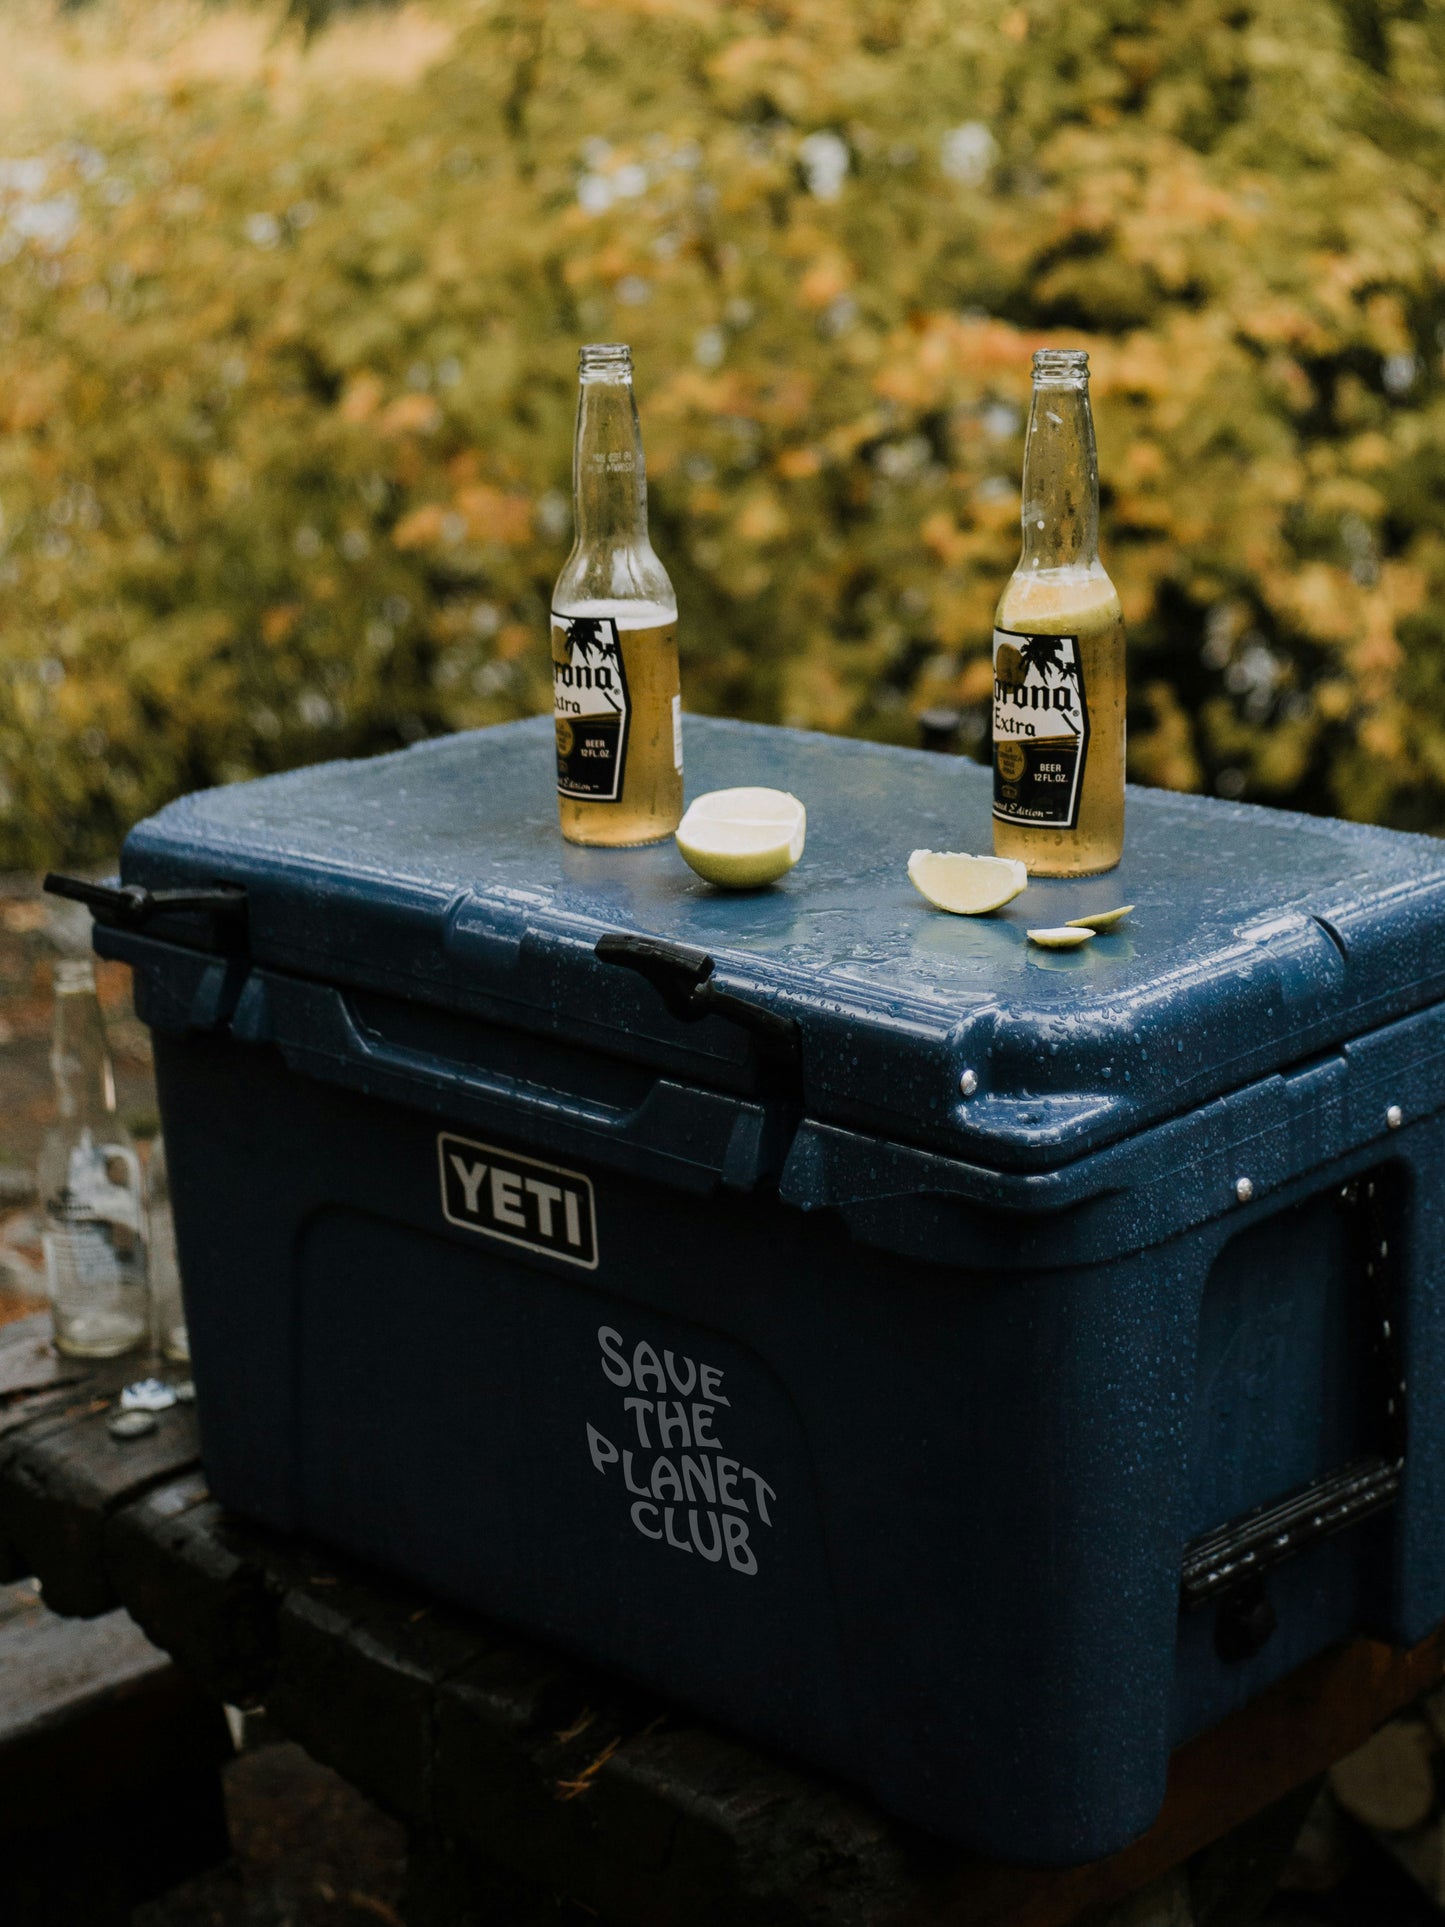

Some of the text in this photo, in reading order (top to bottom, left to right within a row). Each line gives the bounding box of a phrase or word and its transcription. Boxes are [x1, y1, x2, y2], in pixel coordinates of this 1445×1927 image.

[995, 707, 1036, 737] Extra
[585, 739, 606, 748] BEER
[1033, 773, 1042, 782] 12
[1040, 763, 1062, 772] BEER
[1008, 802, 1044, 818] Edition
[449, 1154, 582, 1247] YETI
[598, 1325, 732, 1407] SAVE
[624, 1397, 723, 1450] THE
[586, 1421, 777, 1527] PLANET
[630, 1501, 759, 1575] CLUB
